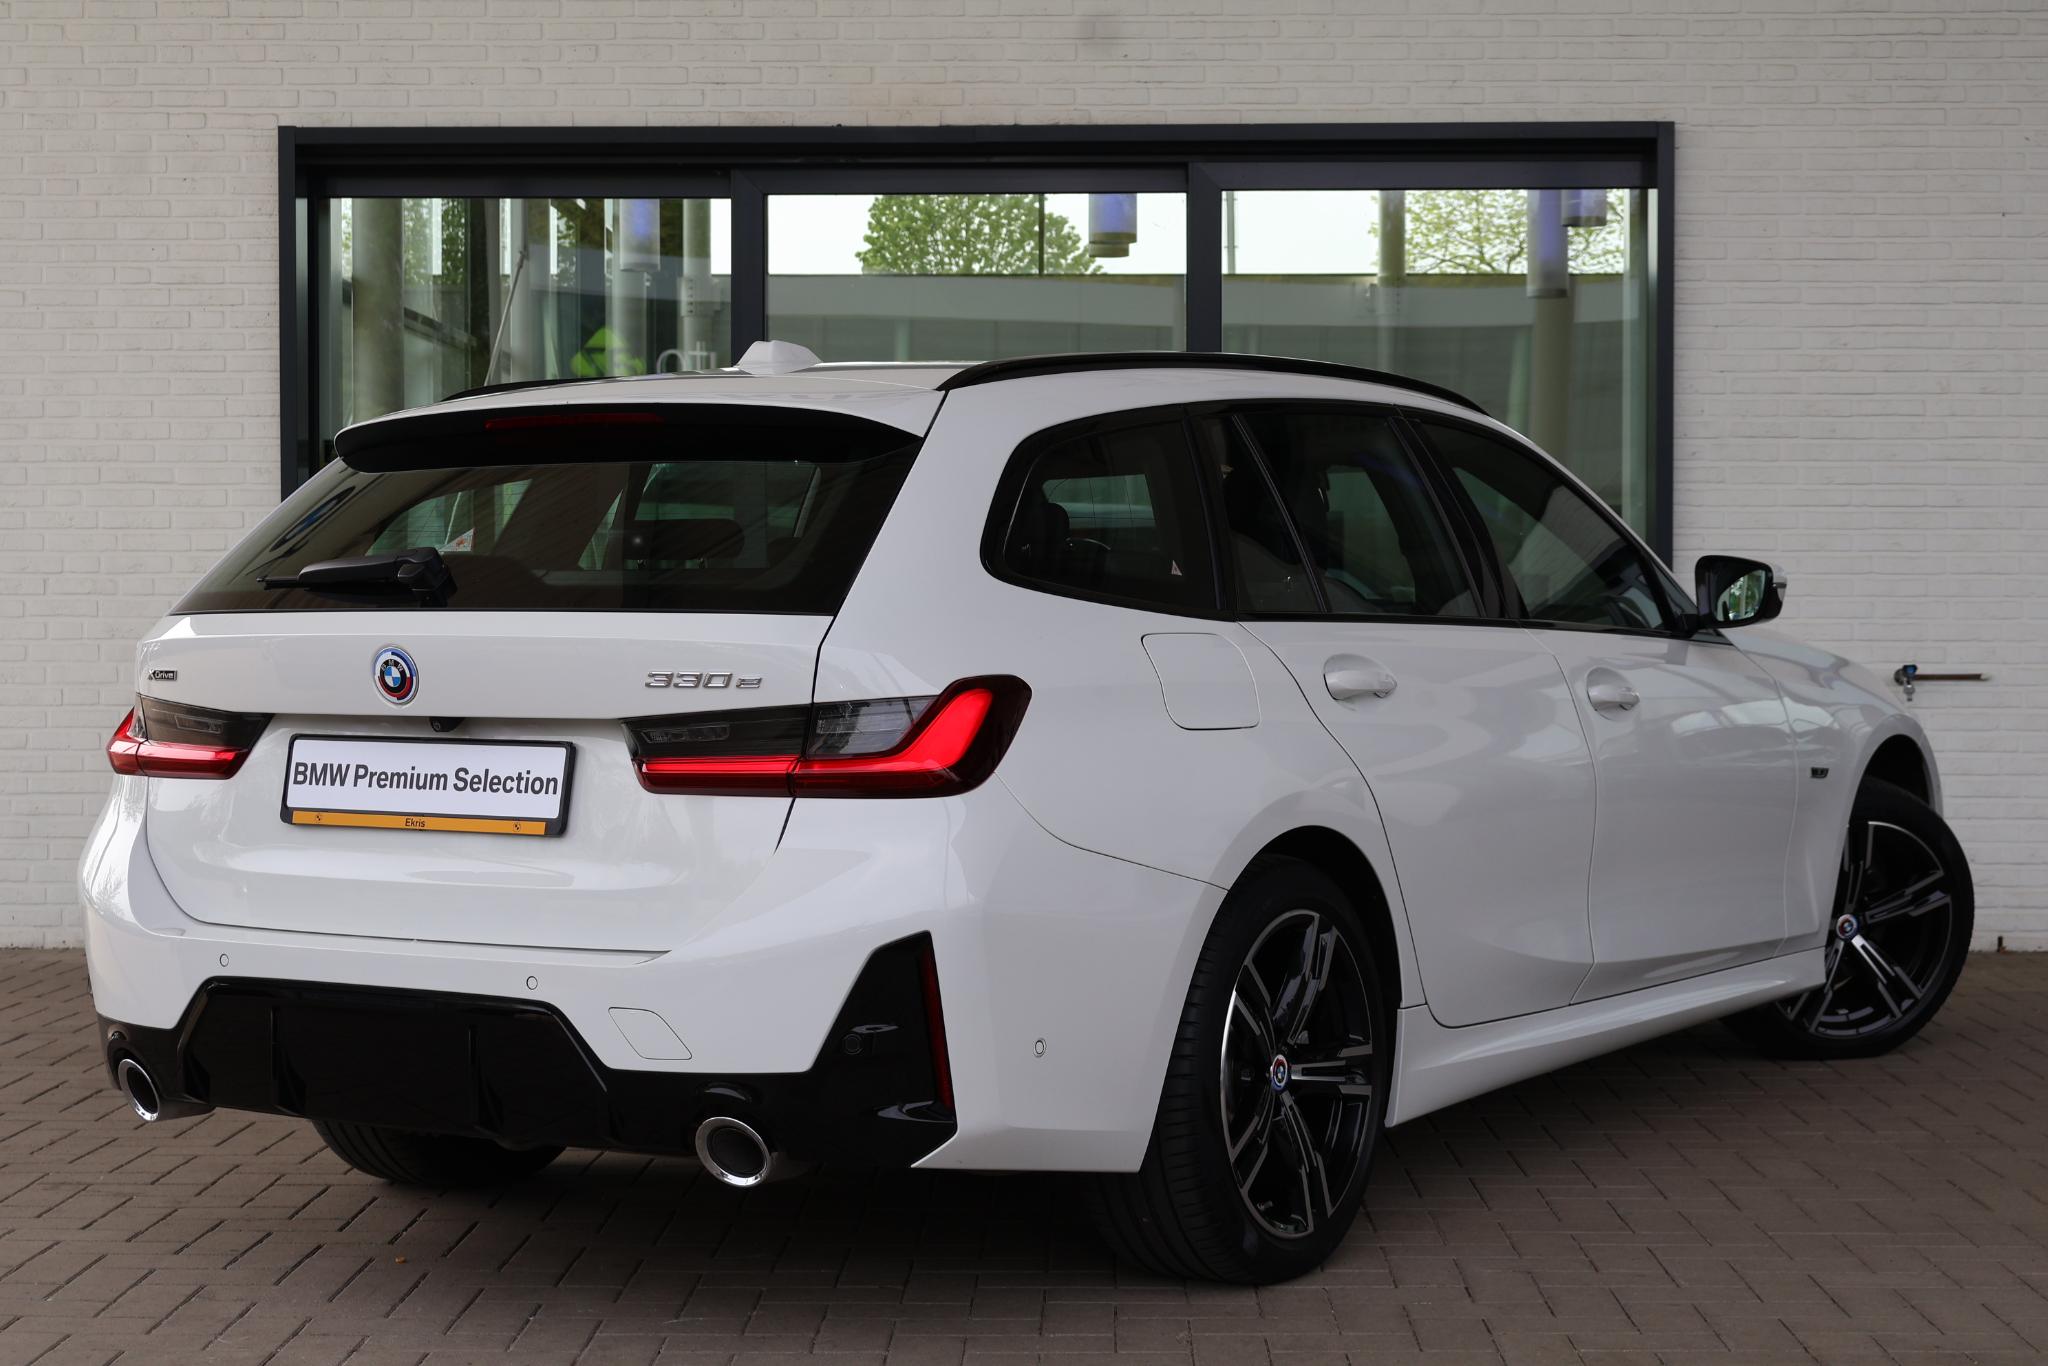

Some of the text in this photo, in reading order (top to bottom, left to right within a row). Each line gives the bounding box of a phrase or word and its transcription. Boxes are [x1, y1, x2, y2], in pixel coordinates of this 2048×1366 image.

[380, 659, 404, 671] BMW
[292, 762, 559, 795] BMW Premium Selection
[405, 817, 426, 829] Ekris
